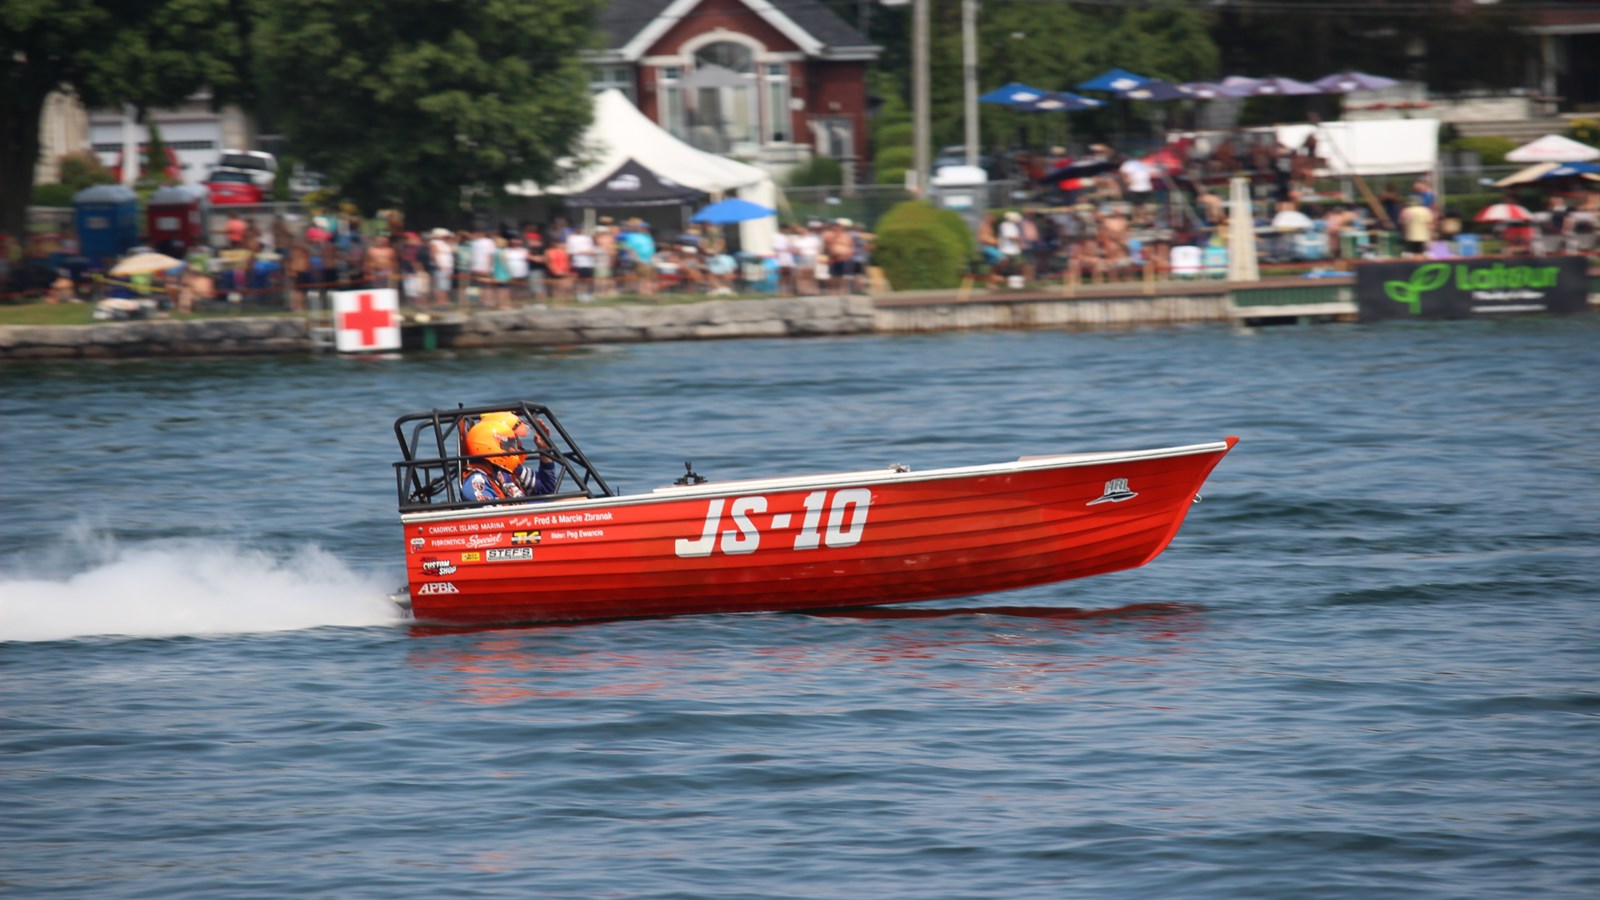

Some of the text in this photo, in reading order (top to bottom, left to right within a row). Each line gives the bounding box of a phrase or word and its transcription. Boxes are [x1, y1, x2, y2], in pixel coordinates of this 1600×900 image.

[534, 516, 550, 524] Fred
[552, 516, 558, 524] &
[559, 514, 582, 523] Marcie
[675, 487, 872, 558] JS-10
[428, 526, 458, 534] CHADWICK
[460, 524, 479, 532] ISLAND
[480, 522, 505, 530] MARINA
[566, 530, 578, 539] Peg
[466, 533, 502, 548] Special
[423, 560, 450, 570] CUSTOM
[439, 566, 457, 575] SHOP
[418, 582, 460, 594] APBA
